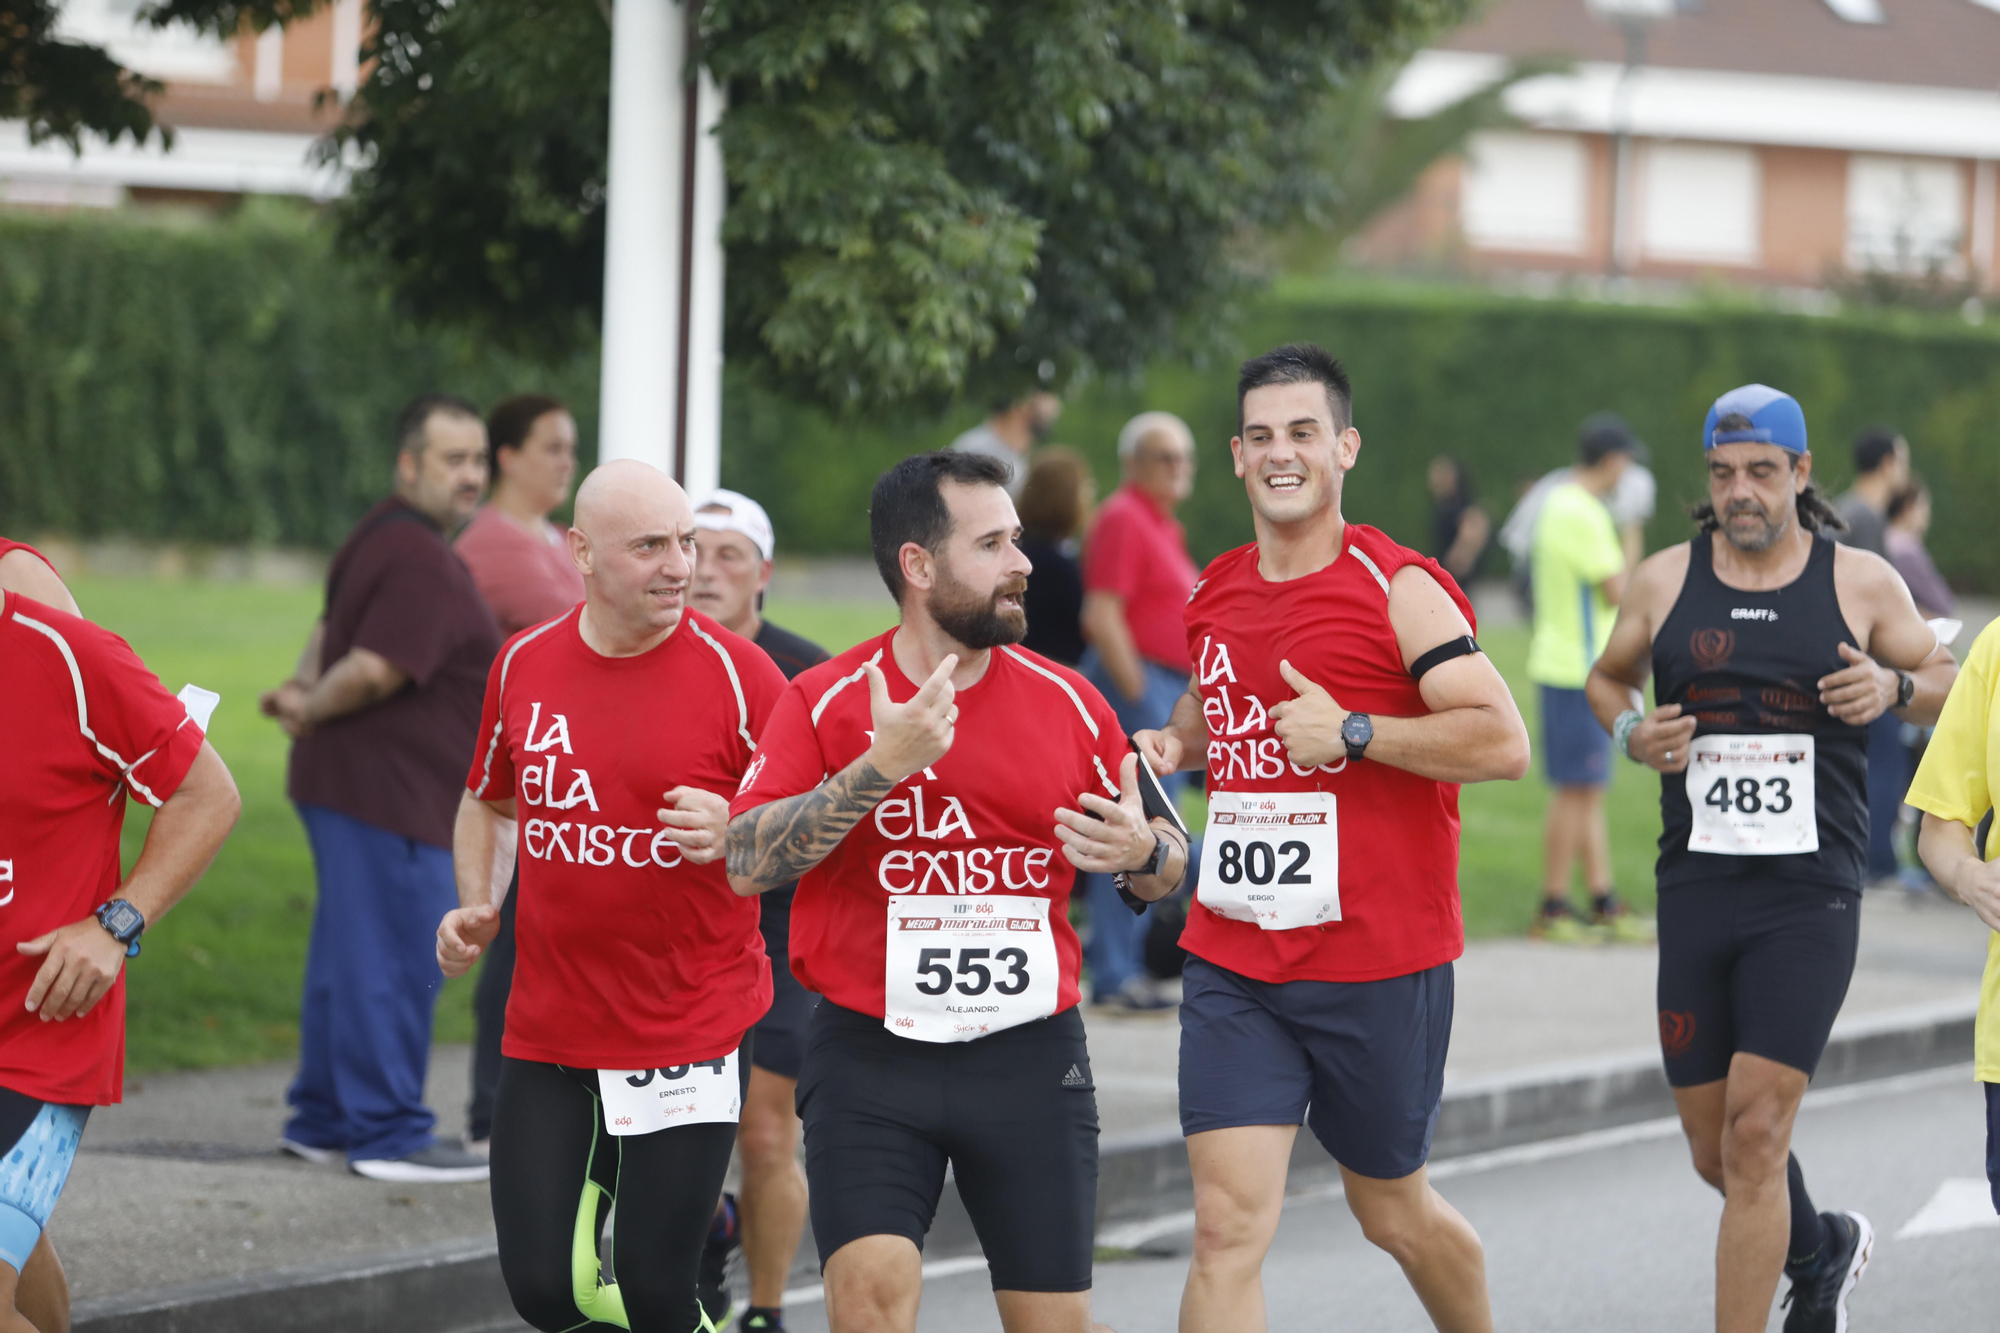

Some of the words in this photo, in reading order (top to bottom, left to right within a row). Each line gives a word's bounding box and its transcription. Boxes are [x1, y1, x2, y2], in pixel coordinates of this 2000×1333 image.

[1731, 608, 1769, 620] CRAFT
[1200, 635, 1238, 686] LA
[524, 702, 574, 755] LA
[1207, 738, 1347, 780] EXIS
[1705, 777, 1793, 814] 483
[1260, 799, 1277, 812] edp
[1218, 840, 1312, 885] 802
[1247, 894, 1275, 902] SERGIO
[975, 902, 994, 916] edp
[905, 920, 937, 929] MEDIA
[1009, 918, 1036, 931] GIJÓN
[915, 947, 1030, 996] 553
[945, 1005, 1000, 1013] ALEJANDRO
[895, 1016, 914, 1030] edp
[1061, 1076, 1086, 1086] adidas
[659, 1086, 697, 1099] ERNESTO
[615, 1116, 632, 1127] edp
